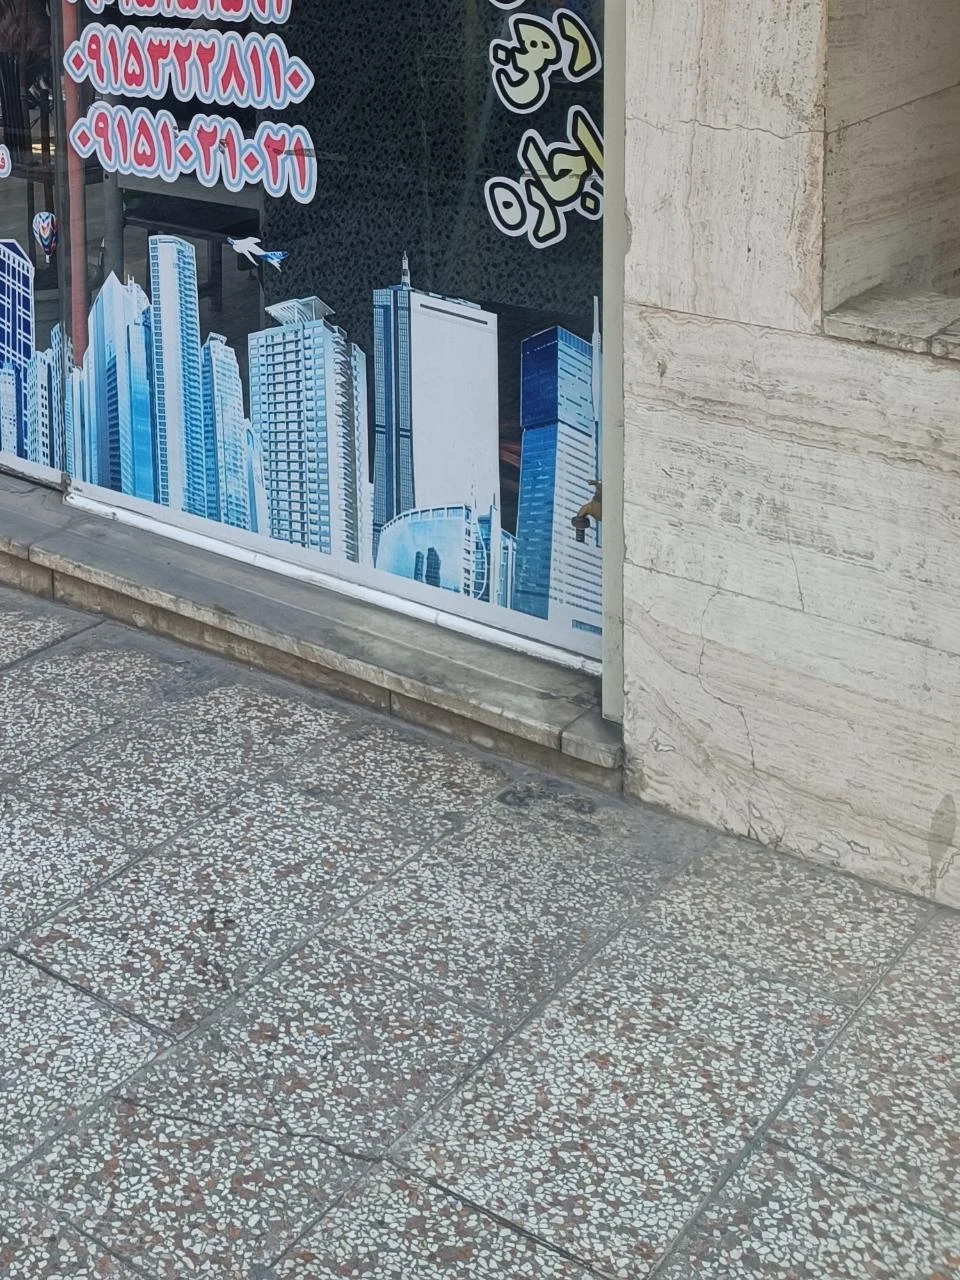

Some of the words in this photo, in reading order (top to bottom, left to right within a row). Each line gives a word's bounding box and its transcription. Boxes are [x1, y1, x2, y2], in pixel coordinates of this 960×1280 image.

[66, 26, 312, 106] ۰۹۱۵۳۲۲۸۱۱۰
[490, 9, 601, 112] رهن
[72, 104, 315, 201] ۰۹۱۵۱۰۲۱۰۲۱
[485, 105, 604, 247] اجاره
